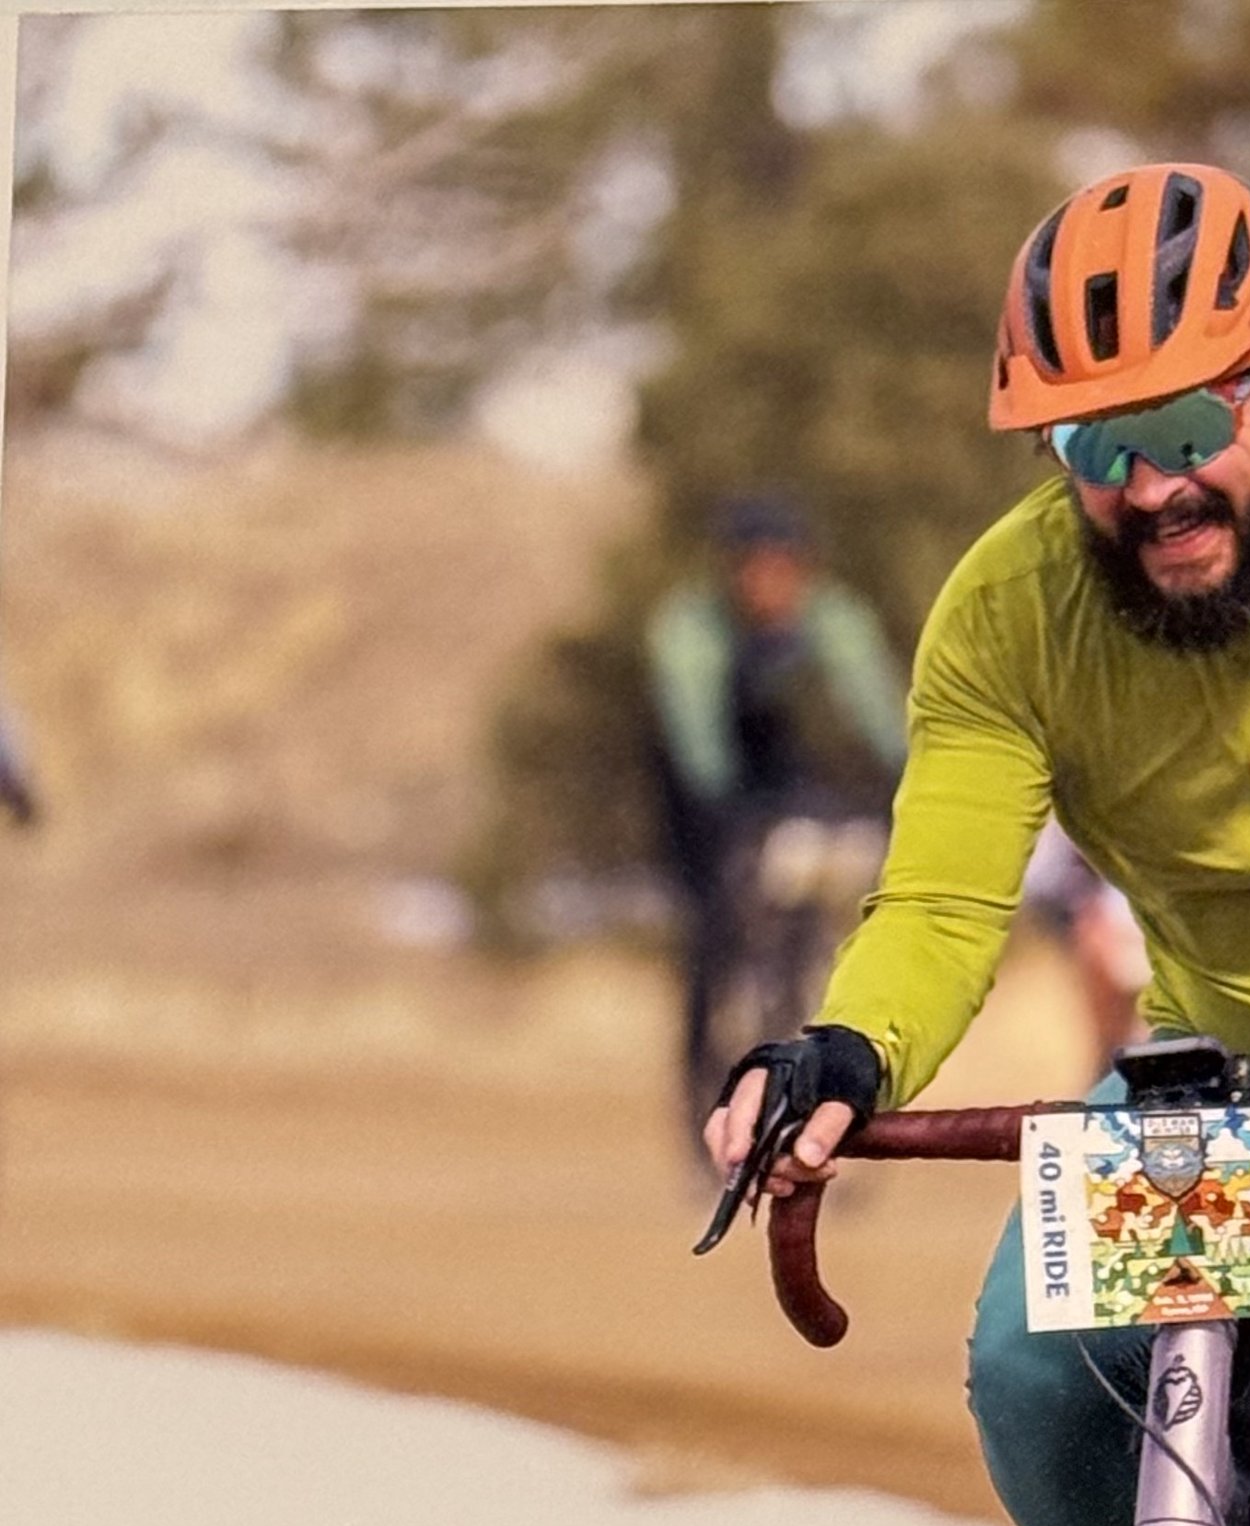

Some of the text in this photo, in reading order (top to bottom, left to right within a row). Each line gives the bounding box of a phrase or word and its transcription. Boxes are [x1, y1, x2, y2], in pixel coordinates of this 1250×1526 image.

[1038, 1141, 1070, 1299] 40 mi RIDE
